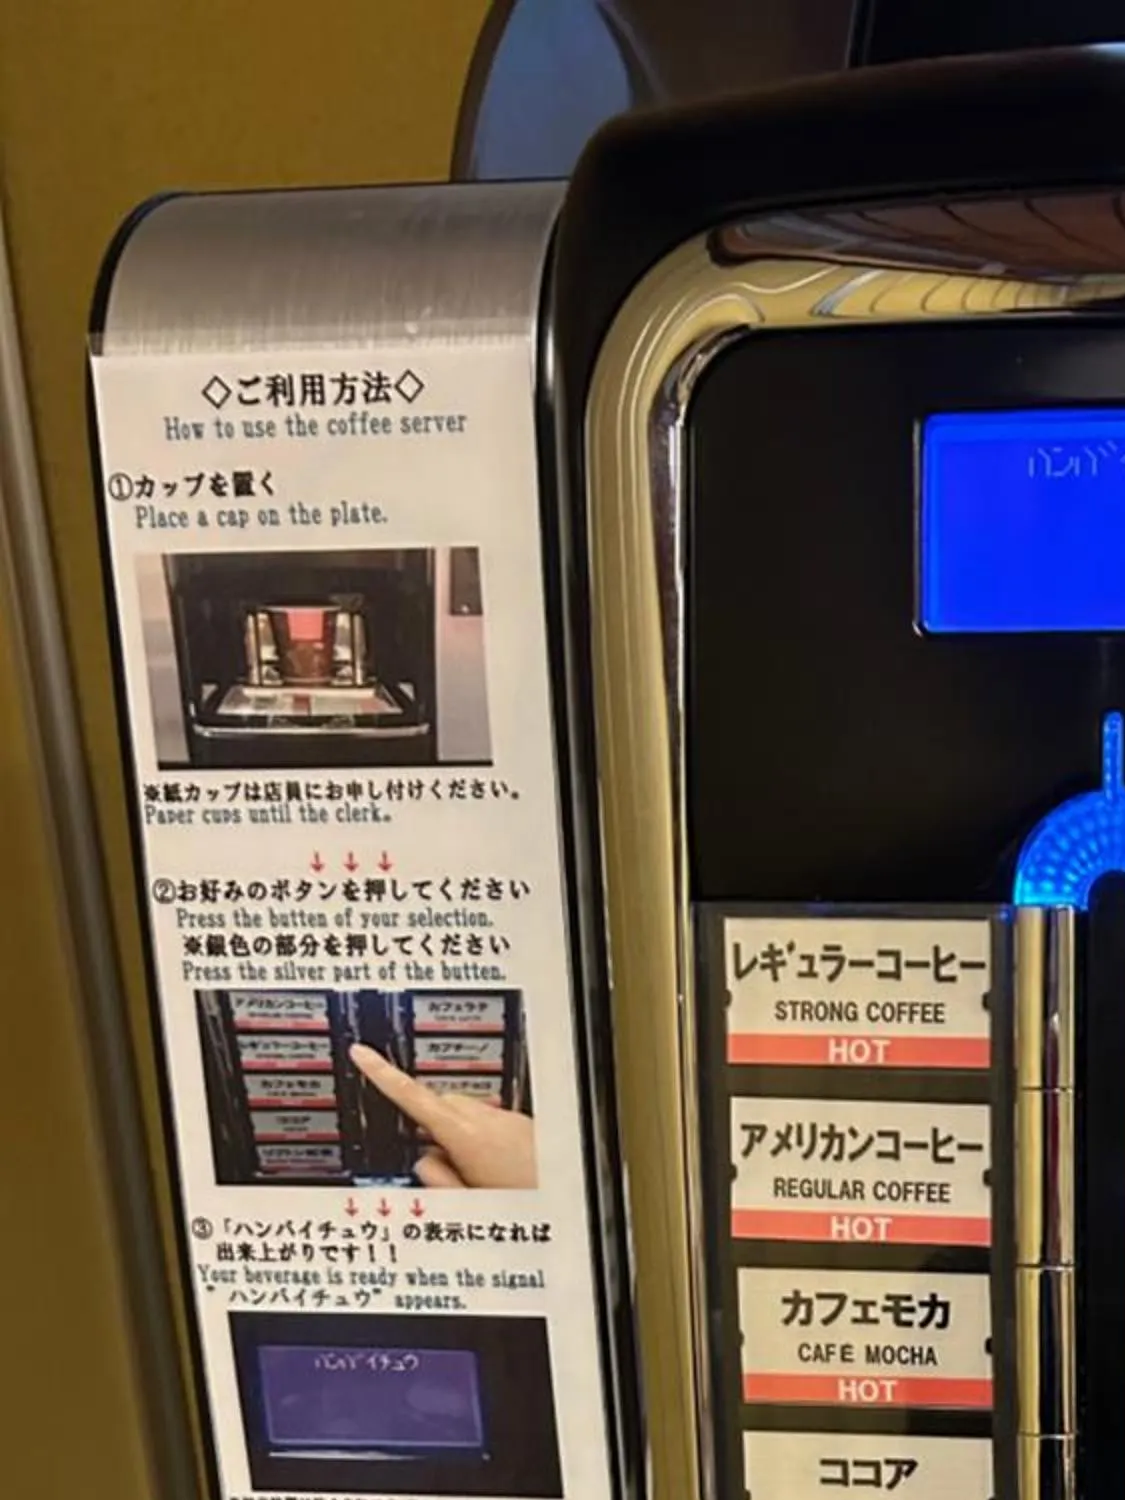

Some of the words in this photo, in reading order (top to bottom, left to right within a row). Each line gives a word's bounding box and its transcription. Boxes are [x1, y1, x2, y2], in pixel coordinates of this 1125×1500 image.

[163, 416, 204, 440] How
[214, 418, 234, 439] to
[242, 419, 276, 438] use
[285, 413, 318, 437] the
[327, 411, 392, 436] coffee
[400, 413, 467, 434] server
[135, 504, 189, 529] Place
[197, 511, 208, 526] a
[217, 508, 249, 529] cap
[257, 507, 280, 526] on
[289, 502, 322, 525] the
[331, 500, 388, 526] plate.
[248, 802, 292, 824] until
[299, 802, 329, 824] the
[335, 801, 392, 823] clerk.
[176, 907, 226, 929] Press
[233, 907, 263, 929] the
[334, 907, 353, 928] of
[360, 911, 399, 929] your
[408, 907, 494, 928] selection.
[182, 960, 232, 982] Press
[238, 960, 268, 982] the
[273, 960, 327, 981] silver
[333, 962, 371, 983] part
[378, 960, 397, 980] of
[404, 960, 435, 981] the
[732, 941, 987, 983] レギュラーコーヒー
[774, 1000, 858, 1022] STRONG
[866, 1002, 945, 1024] COFFEE
[828, 1038, 891, 1063] HOT
[740, 1122, 983, 1164] アメリカンコーヒー
[773, 1177, 864, 1200] REGULAR
[873, 1181, 950, 1203] COFFEE
[831, 1215, 892, 1240] HOT
[198, 1264, 238, 1284] Your
[244, 1265, 321, 1286] beverage
[327, 1267, 344, 1285] is
[351, 1267, 397, 1288] ready
[405, 1268, 449, 1287] when
[455, 1268, 485, 1287] the
[492, 1269, 545, 1290] signal
[395, 1295, 467, 1310] appears.
[781, 1289, 951, 1329] カフェモカ
[865, 1345, 938, 1366] MOCHA
[837, 1379, 898, 1402] HOT
[819, 1457, 918, 1490] ココア
